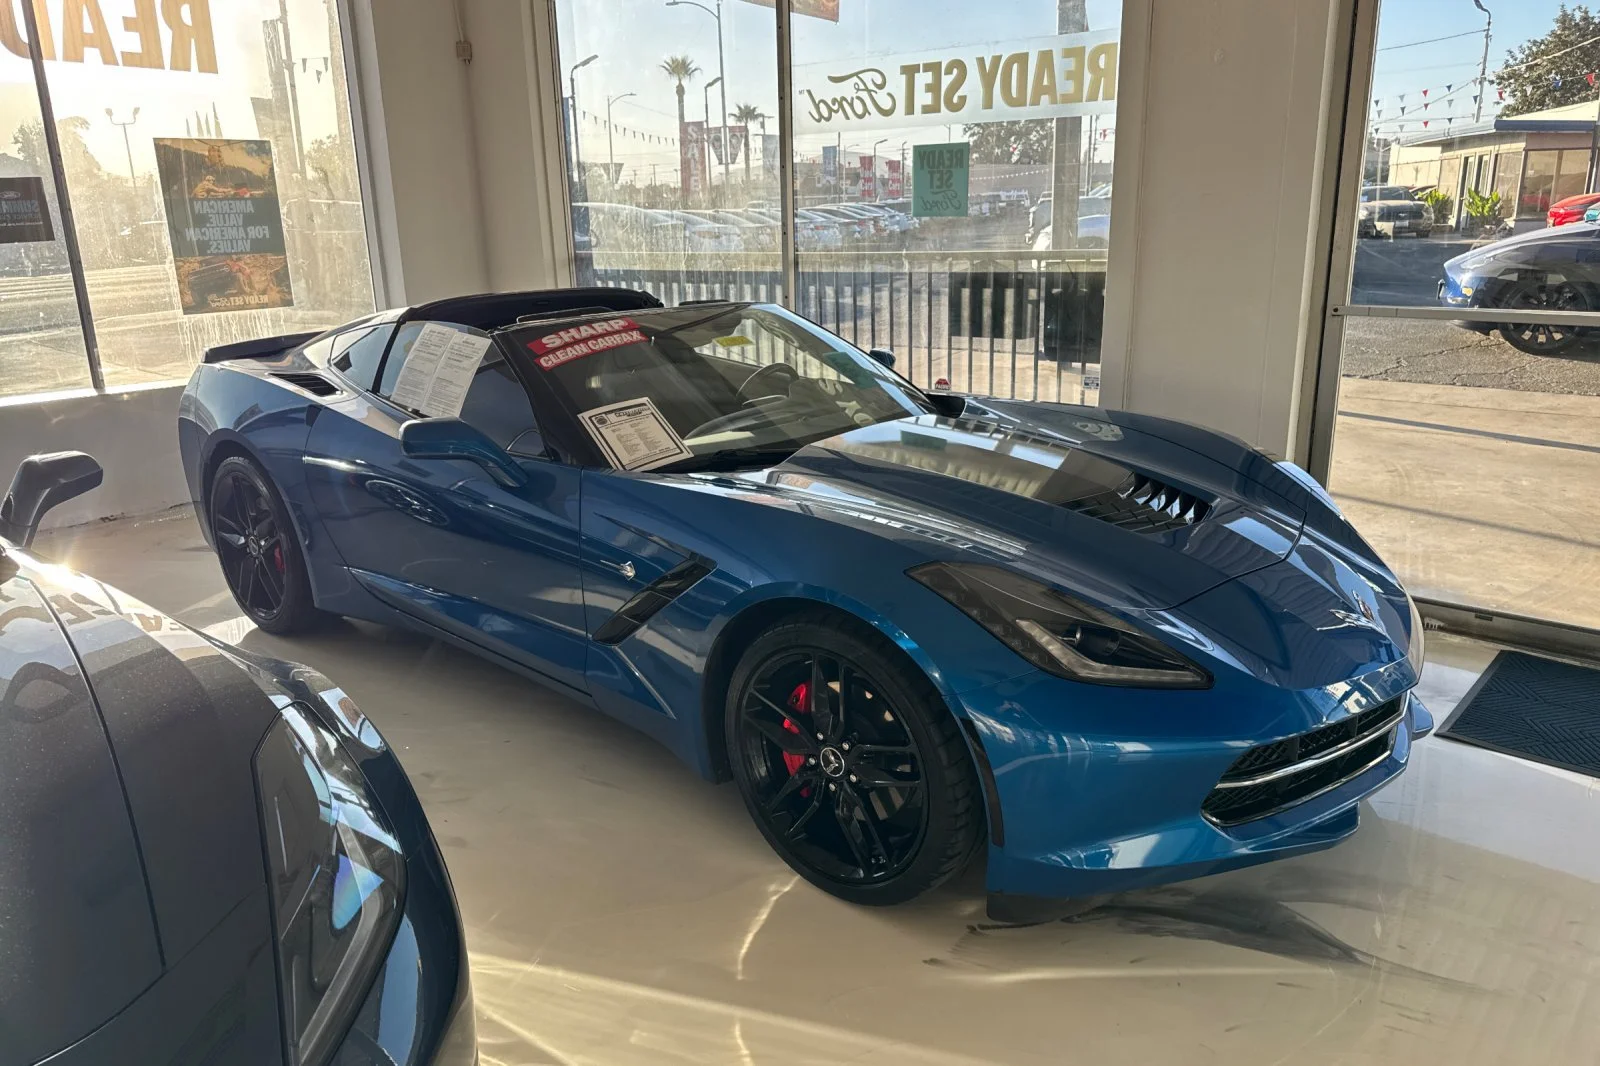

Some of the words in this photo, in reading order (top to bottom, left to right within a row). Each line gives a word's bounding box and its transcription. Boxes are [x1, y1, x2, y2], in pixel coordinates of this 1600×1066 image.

[539, 342, 587, 368] CLEAN
[587, 330, 644, 354] CARFAX
[541, 318, 629, 348] SHARP
